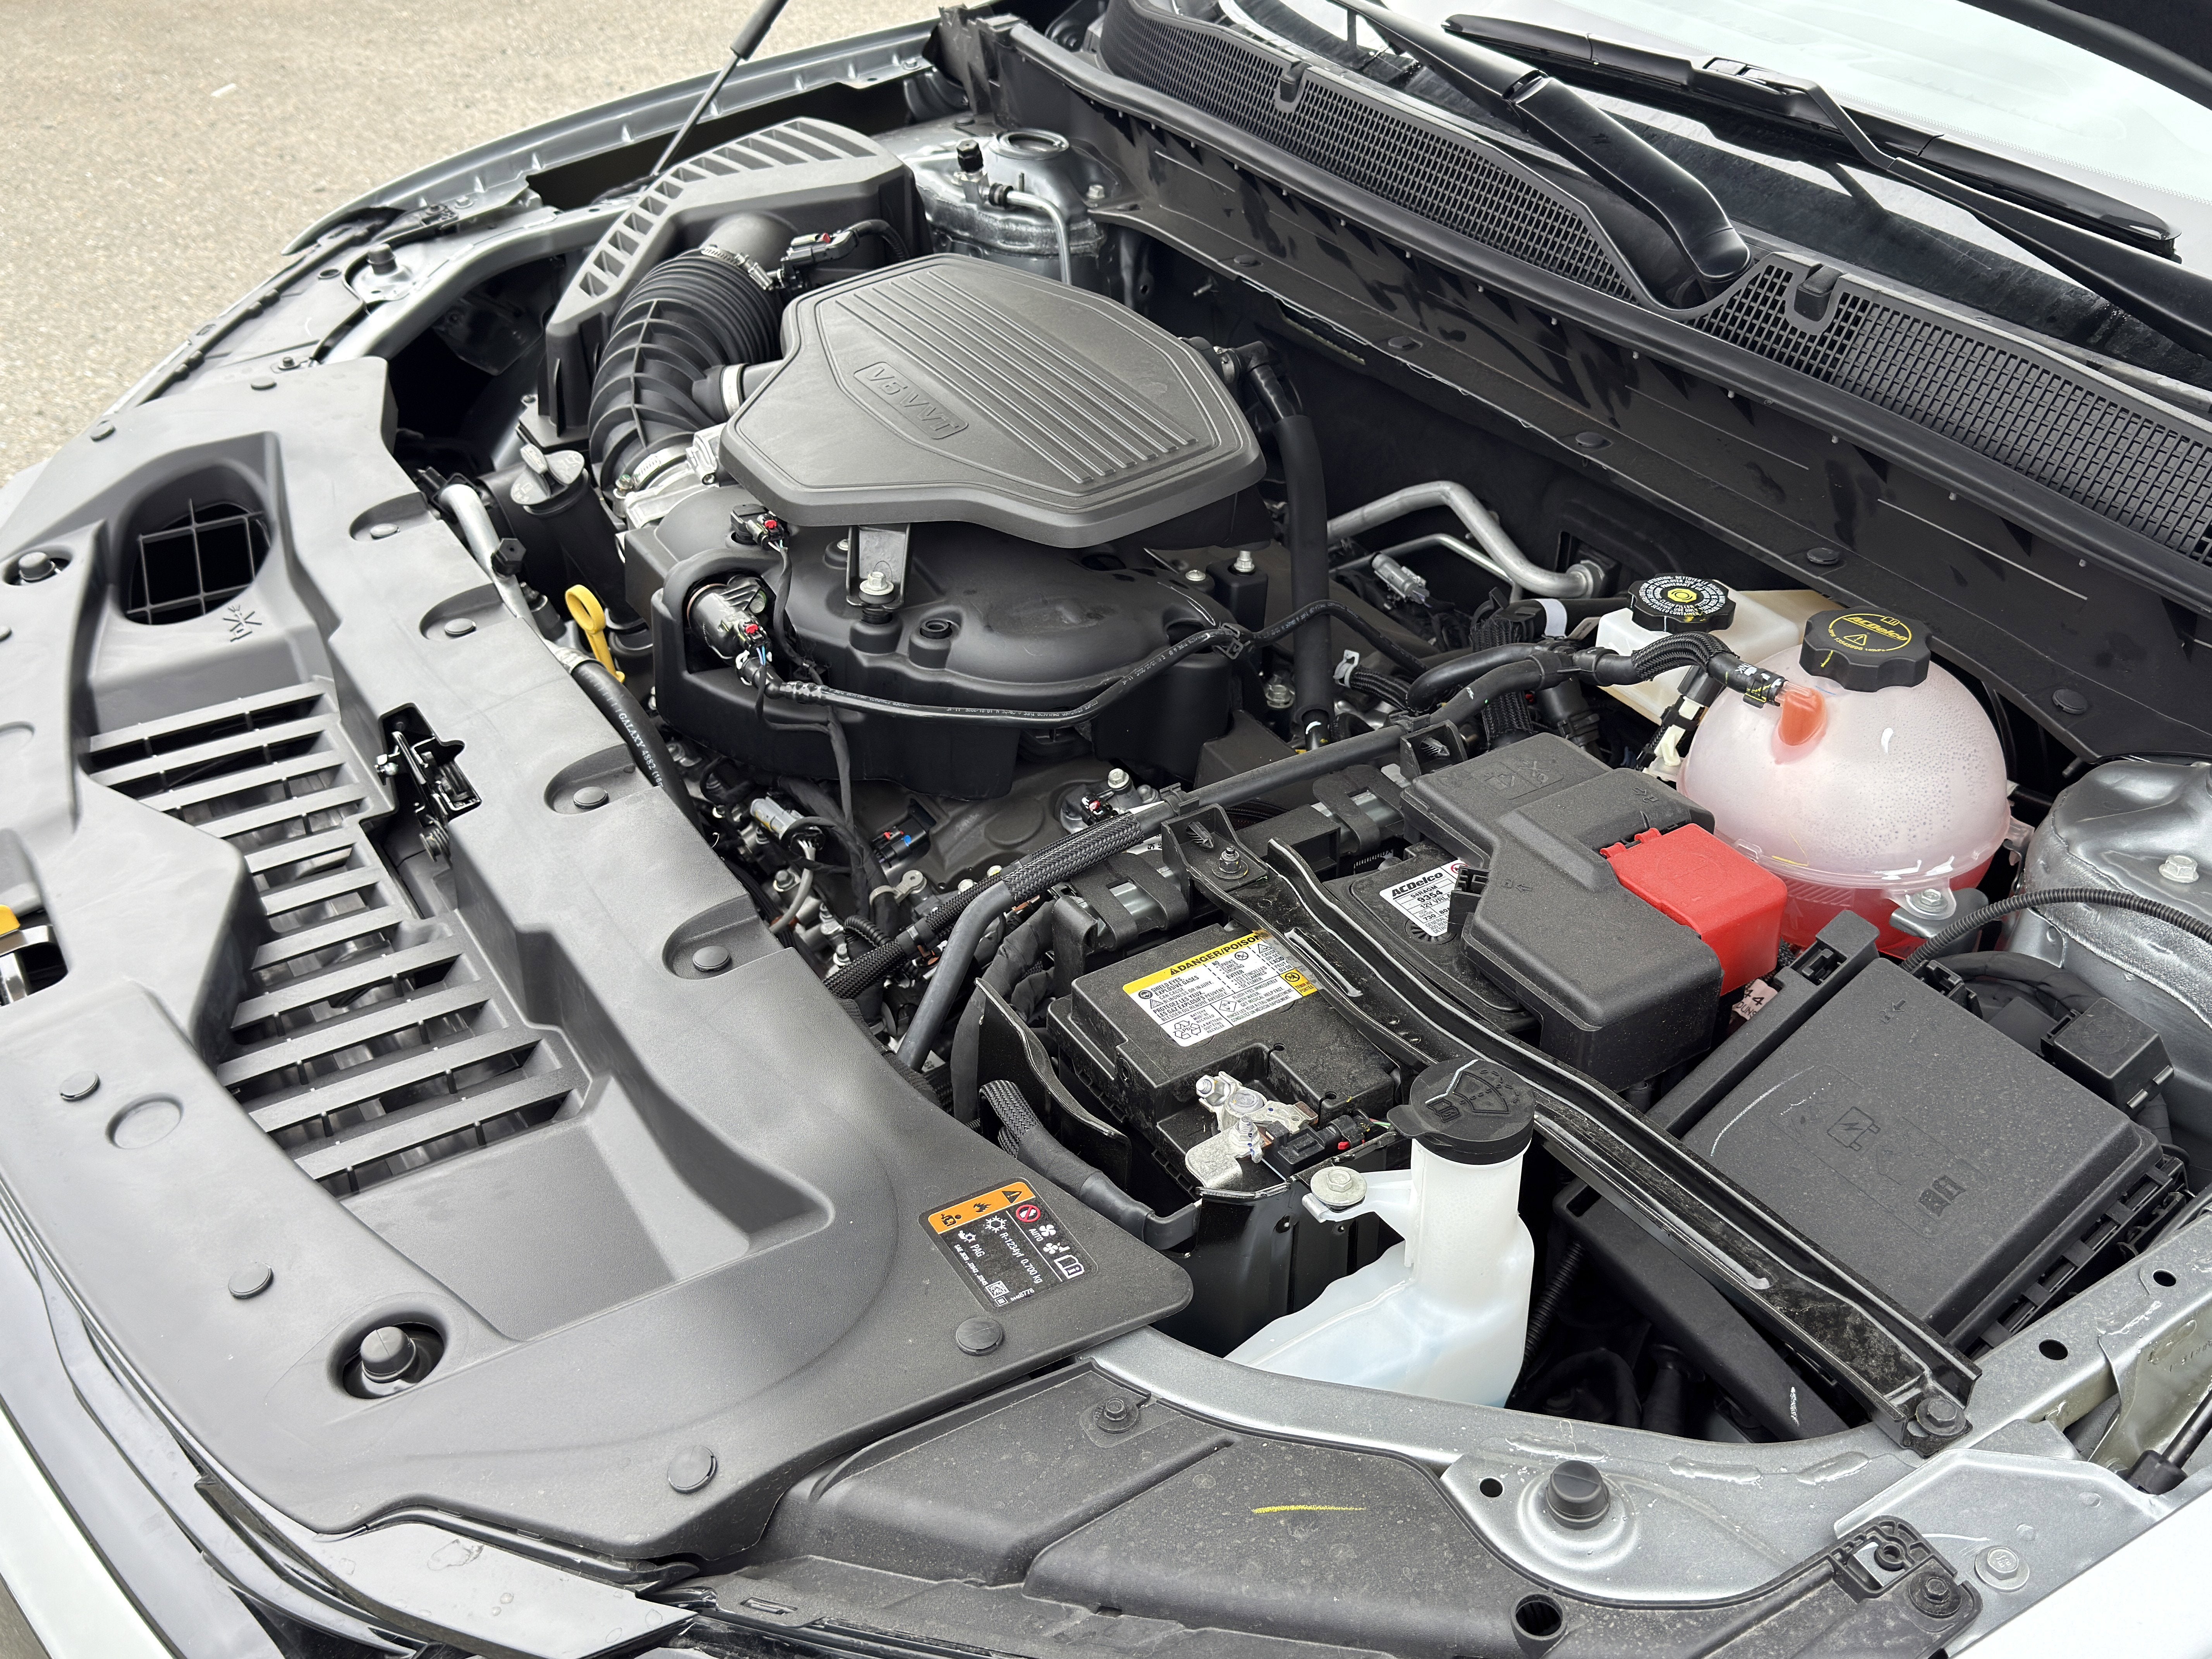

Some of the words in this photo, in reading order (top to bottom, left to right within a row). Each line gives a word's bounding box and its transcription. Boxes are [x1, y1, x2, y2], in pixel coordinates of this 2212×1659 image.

[866, 367, 908, 395] V6
[900, 393, 959, 431] VVT
[1650, 604, 1670, 613] SEALED
[1659, 599, 1675, 607] CLEAN
[1847, 617, 1908, 641] ACDelco
[619, 713, 646, 747] GALAXY
[642, 750, 656, 770] 4882
[1392, 872, 1443, 896] ACDelco
[1417, 890, 1443, 903] 9354
[1425, 917, 1446, 927] GENERAL
[1224, 965, 1244, 973] SMOKING
[1245, 971, 1267, 981] FLAMMES
[1151, 984, 1170, 992] SHIELD
[1154, 983, 1183, 995] EXPLOSIVE
[1253, 979, 1278, 990] IMMEDIATELY
[1163, 992, 1188, 1003] BLINDNESS
[1195, 981, 1214, 989] INJURY.
[1177, 996, 1206, 1009] EXPLOSIFS
[1204, 988, 1226, 998] PEUVENT
[1161, 1012, 1182, 1021] BLESSER
[1188, 1001, 1208, 1009] RENDRE
[1207, 992, 1230, 1001] AVEUGLE.
[1196, 1015, 1215, 1023] RECYCLED
[1231, 1013, 1250, 1022] CONSULTEZ
[1029, 1228, 1044, 1242] AUTO
[954, 1244, 963, 1252] SAE
[970, 1243, 985, 1257] PAG
[1000, 1232, 1024, 1257] R-1234yf
[1020, 1259, 1038, 1275] 0.700
[1033, 1274, 1043, 1284] kg
